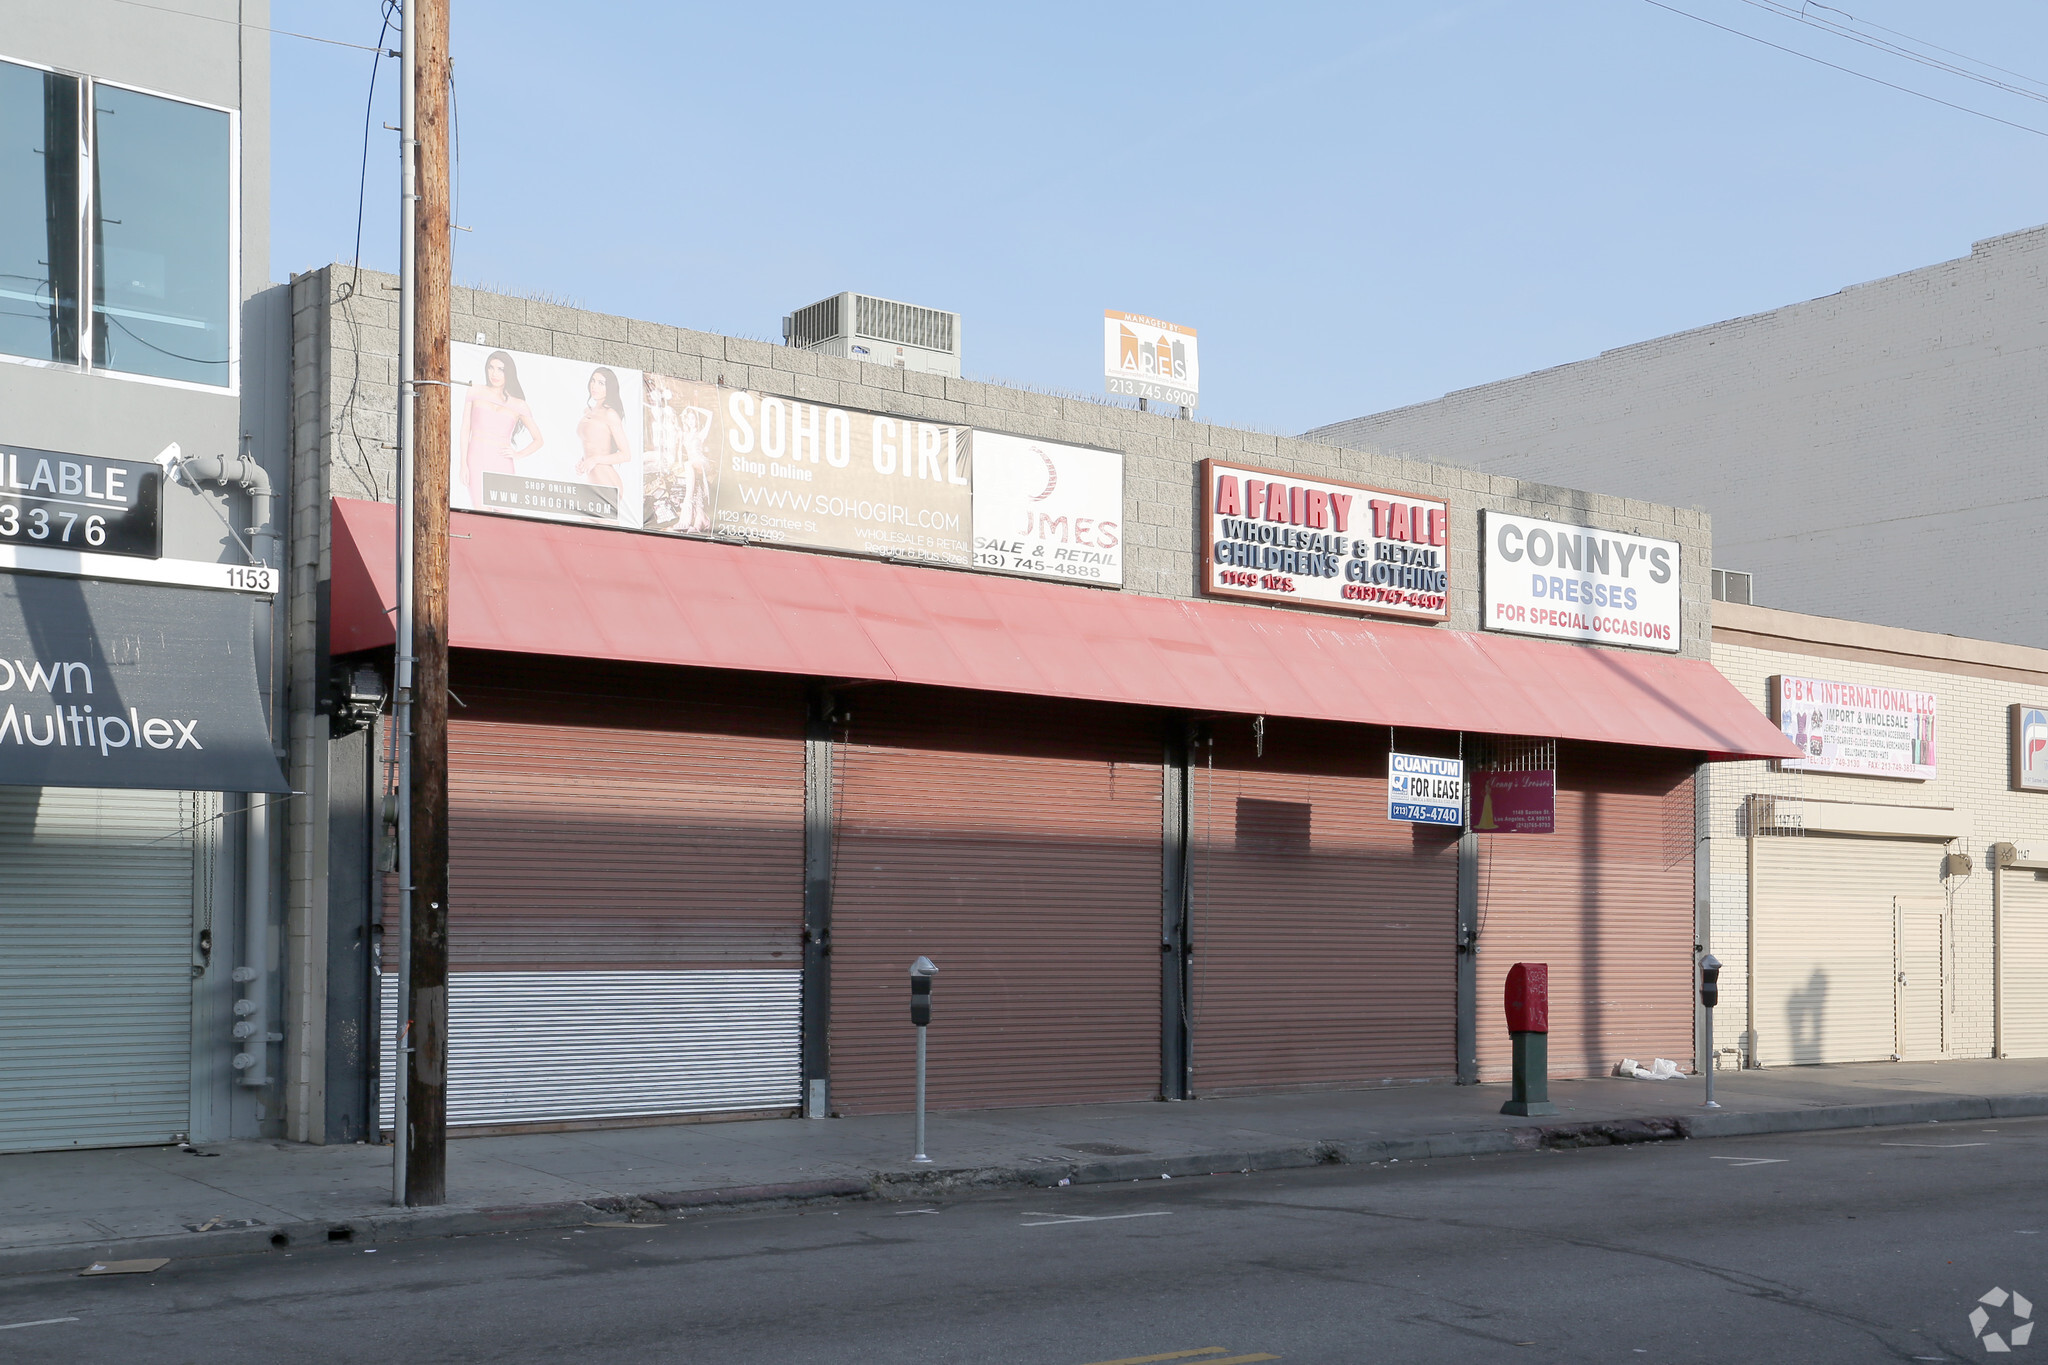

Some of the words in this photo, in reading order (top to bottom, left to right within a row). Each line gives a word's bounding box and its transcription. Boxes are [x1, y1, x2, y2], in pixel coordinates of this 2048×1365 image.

[1124, 313, 1167, 329] MANAGED
[1169, 324, 1181, 333] BY:
[1121, 347, 1187, 380] ARES
[1110, 378, 1196, 407] 213.745.6900
[728, 390, 850, 469] SOHO
[872, 416, 968, 486] GIRL
[731, 456, 766, 477] Shop
[770, 461, 813, 482] Online
[524, 480, 548, 492] SHOP
[548, 483, 577, 496] ONLINE
[489, 490, 611, 515] WWW.SOHOGIRL.COM
[738, 483, 960, 532] WWW.SOHOGIRL.COM
[1216, 474, 1242, 516] A
[1246, 478, 1354, 532] FAIRY
[1369, 498, 1447, 546] TALE
[0, 503, 107, 547] 3376
[717, 510, 740, 522] 1129
[741, 512, 758, 525] 1/2
[760, 514, 801, 530] Santee
[854, 527, 925, 546] WHOLESALE
[926, 537, 935, 547] &
[936, 538, 972, 553] RETAIL
[864, 541, 907, 558] Regular
[907, 546, 916, 557] &
[917, 548, 940, 560] Plus
[941, 550, 969, 565] Sizes
[974, 536, 1025, 554] SALE
[1032, 545, 1046, 557] &
[1054, 547, 1118, 567] RETAIL
[1221, 518, 1349, 556] WHOLESALE
[1352, 538, 1370, 559] &
[1375, 541, 1441, 569] RETAIL
[1214, 539, 1340, 578] CHILDREN'S
[1345, 558, 1449, 592] CLOTHING
[1497, 523, 1672, 584] CONNY'S
[226, 567, 271, 590] 1153
[1013, 557, 1101, 578] 745-4888
[1221, 569, 1259, 586] 1149
[1531, 573, 1638, 611] DRESSES
[1496, 603, 1526, 623] FOR
[1529, 606, 1590, 630] SPECIAL
[1592, 615, 1671, 641] OCCASIONS
[1820, 682, 1913, 713] INTERNATIONAL
[1915, 693, 1935, 716] LLC
[1826, 708, 1855, 724] IMPORT
[1857, 712, 1863, 724] &
[1864, 713, 1909, 729] WHOLESALE
[1394, 756, 1459, 776] QUANTUM
[1806, 755, 1819, 765] TEL:
[1867, 760, 1880, 770] FAX:
[1410, 777, 1430, 798] FOR
[1432, 779, 1460, 800] LEASE
